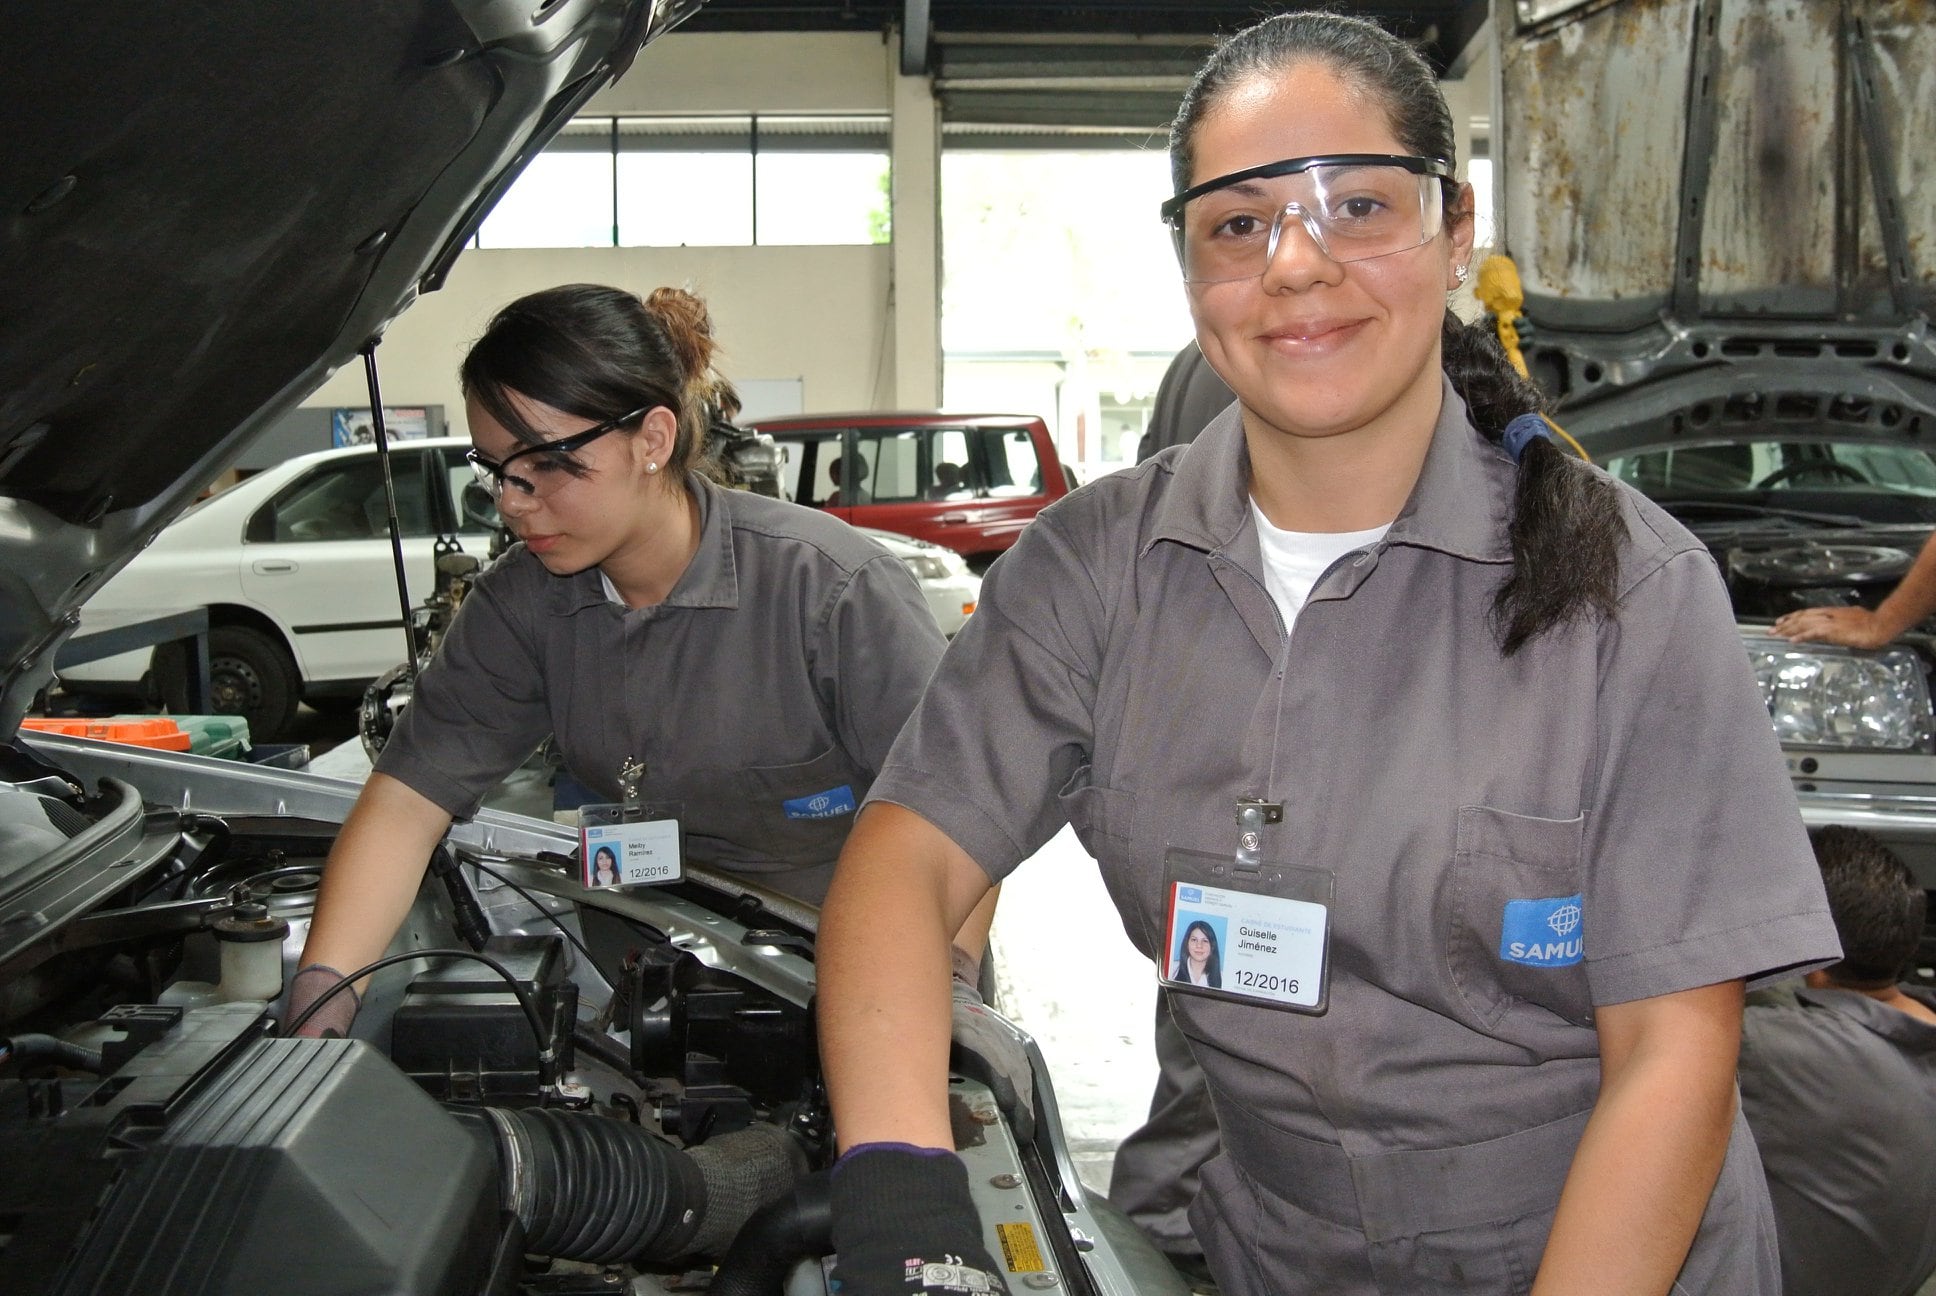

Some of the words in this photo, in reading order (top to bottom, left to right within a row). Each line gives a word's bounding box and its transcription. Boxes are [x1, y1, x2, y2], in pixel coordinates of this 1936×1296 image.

[629, 866, 669, 878] 12/2016
[1239, 926, 1277, 941] Guiselle
[1238, 939, 1277, 954] Jiménez
[1509, 935, 1583, 960] SAMU
[1235, 970, 1299, 994] 12/2016
